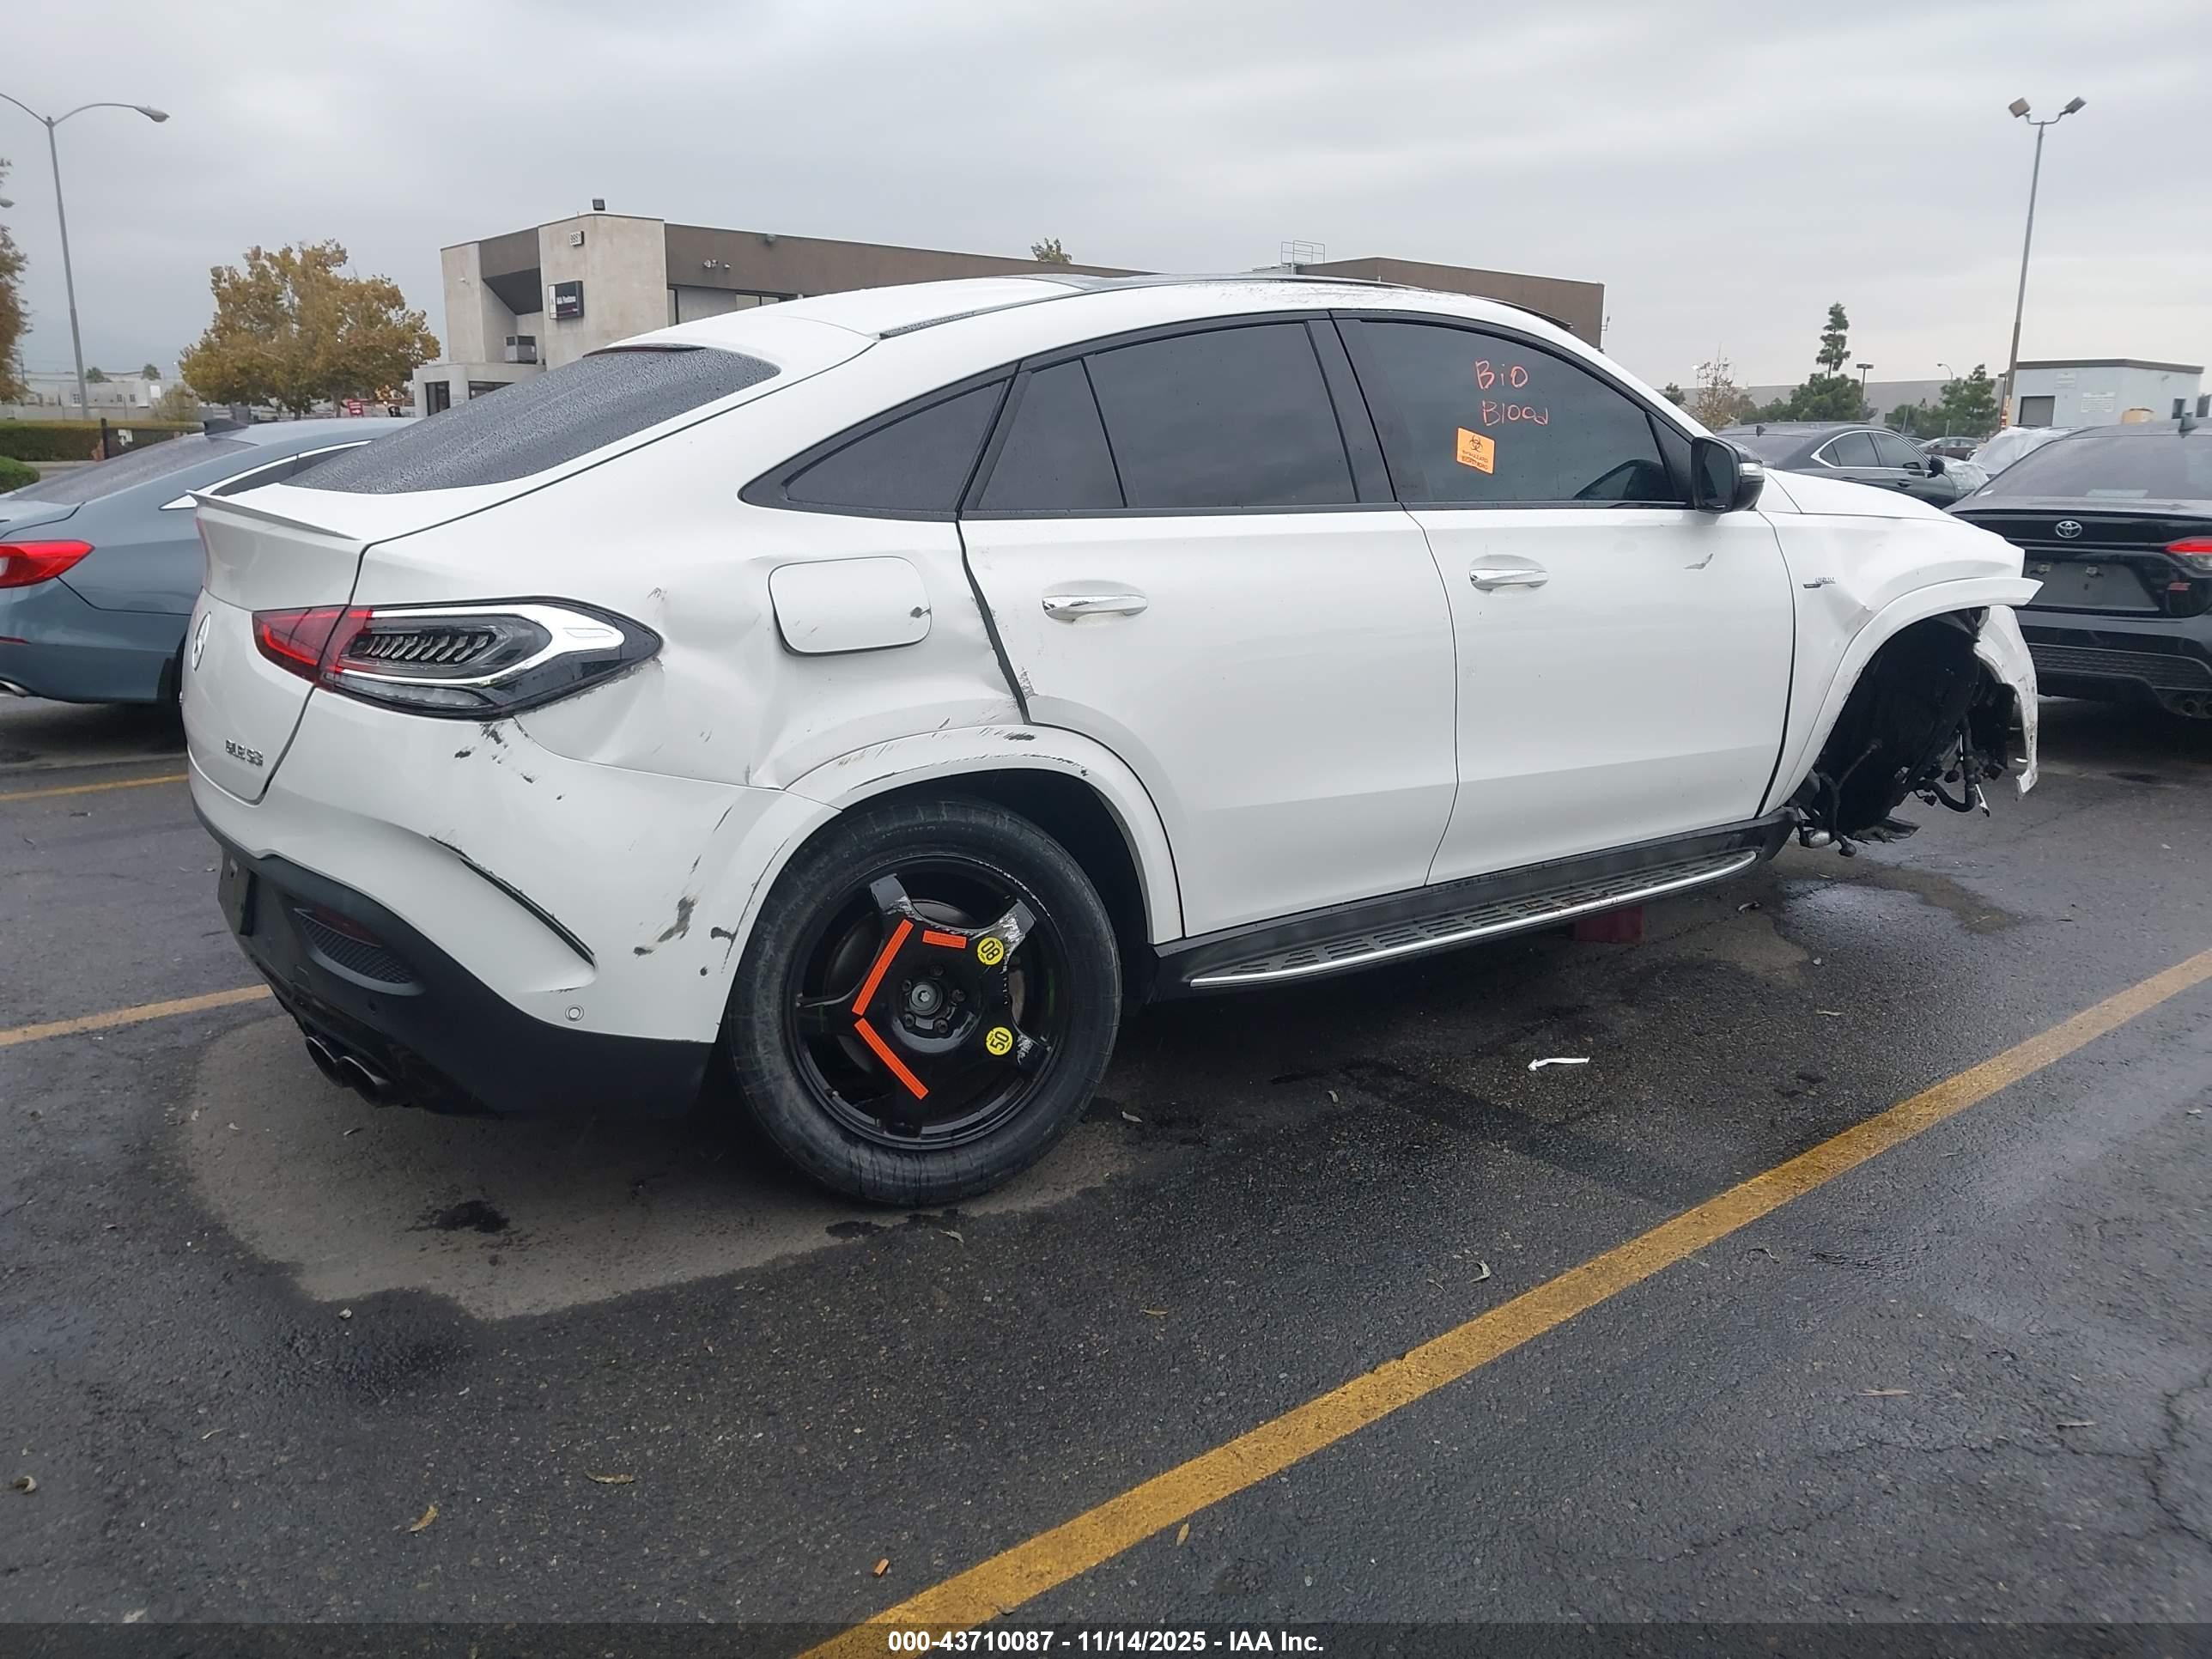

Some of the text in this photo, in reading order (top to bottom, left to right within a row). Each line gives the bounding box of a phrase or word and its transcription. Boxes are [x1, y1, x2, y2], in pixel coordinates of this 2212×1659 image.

[1482, 400, 1549, 427] Blood
[981, 939, 1000, 961] 80
[990, 1030, 1010, 1051] 50
